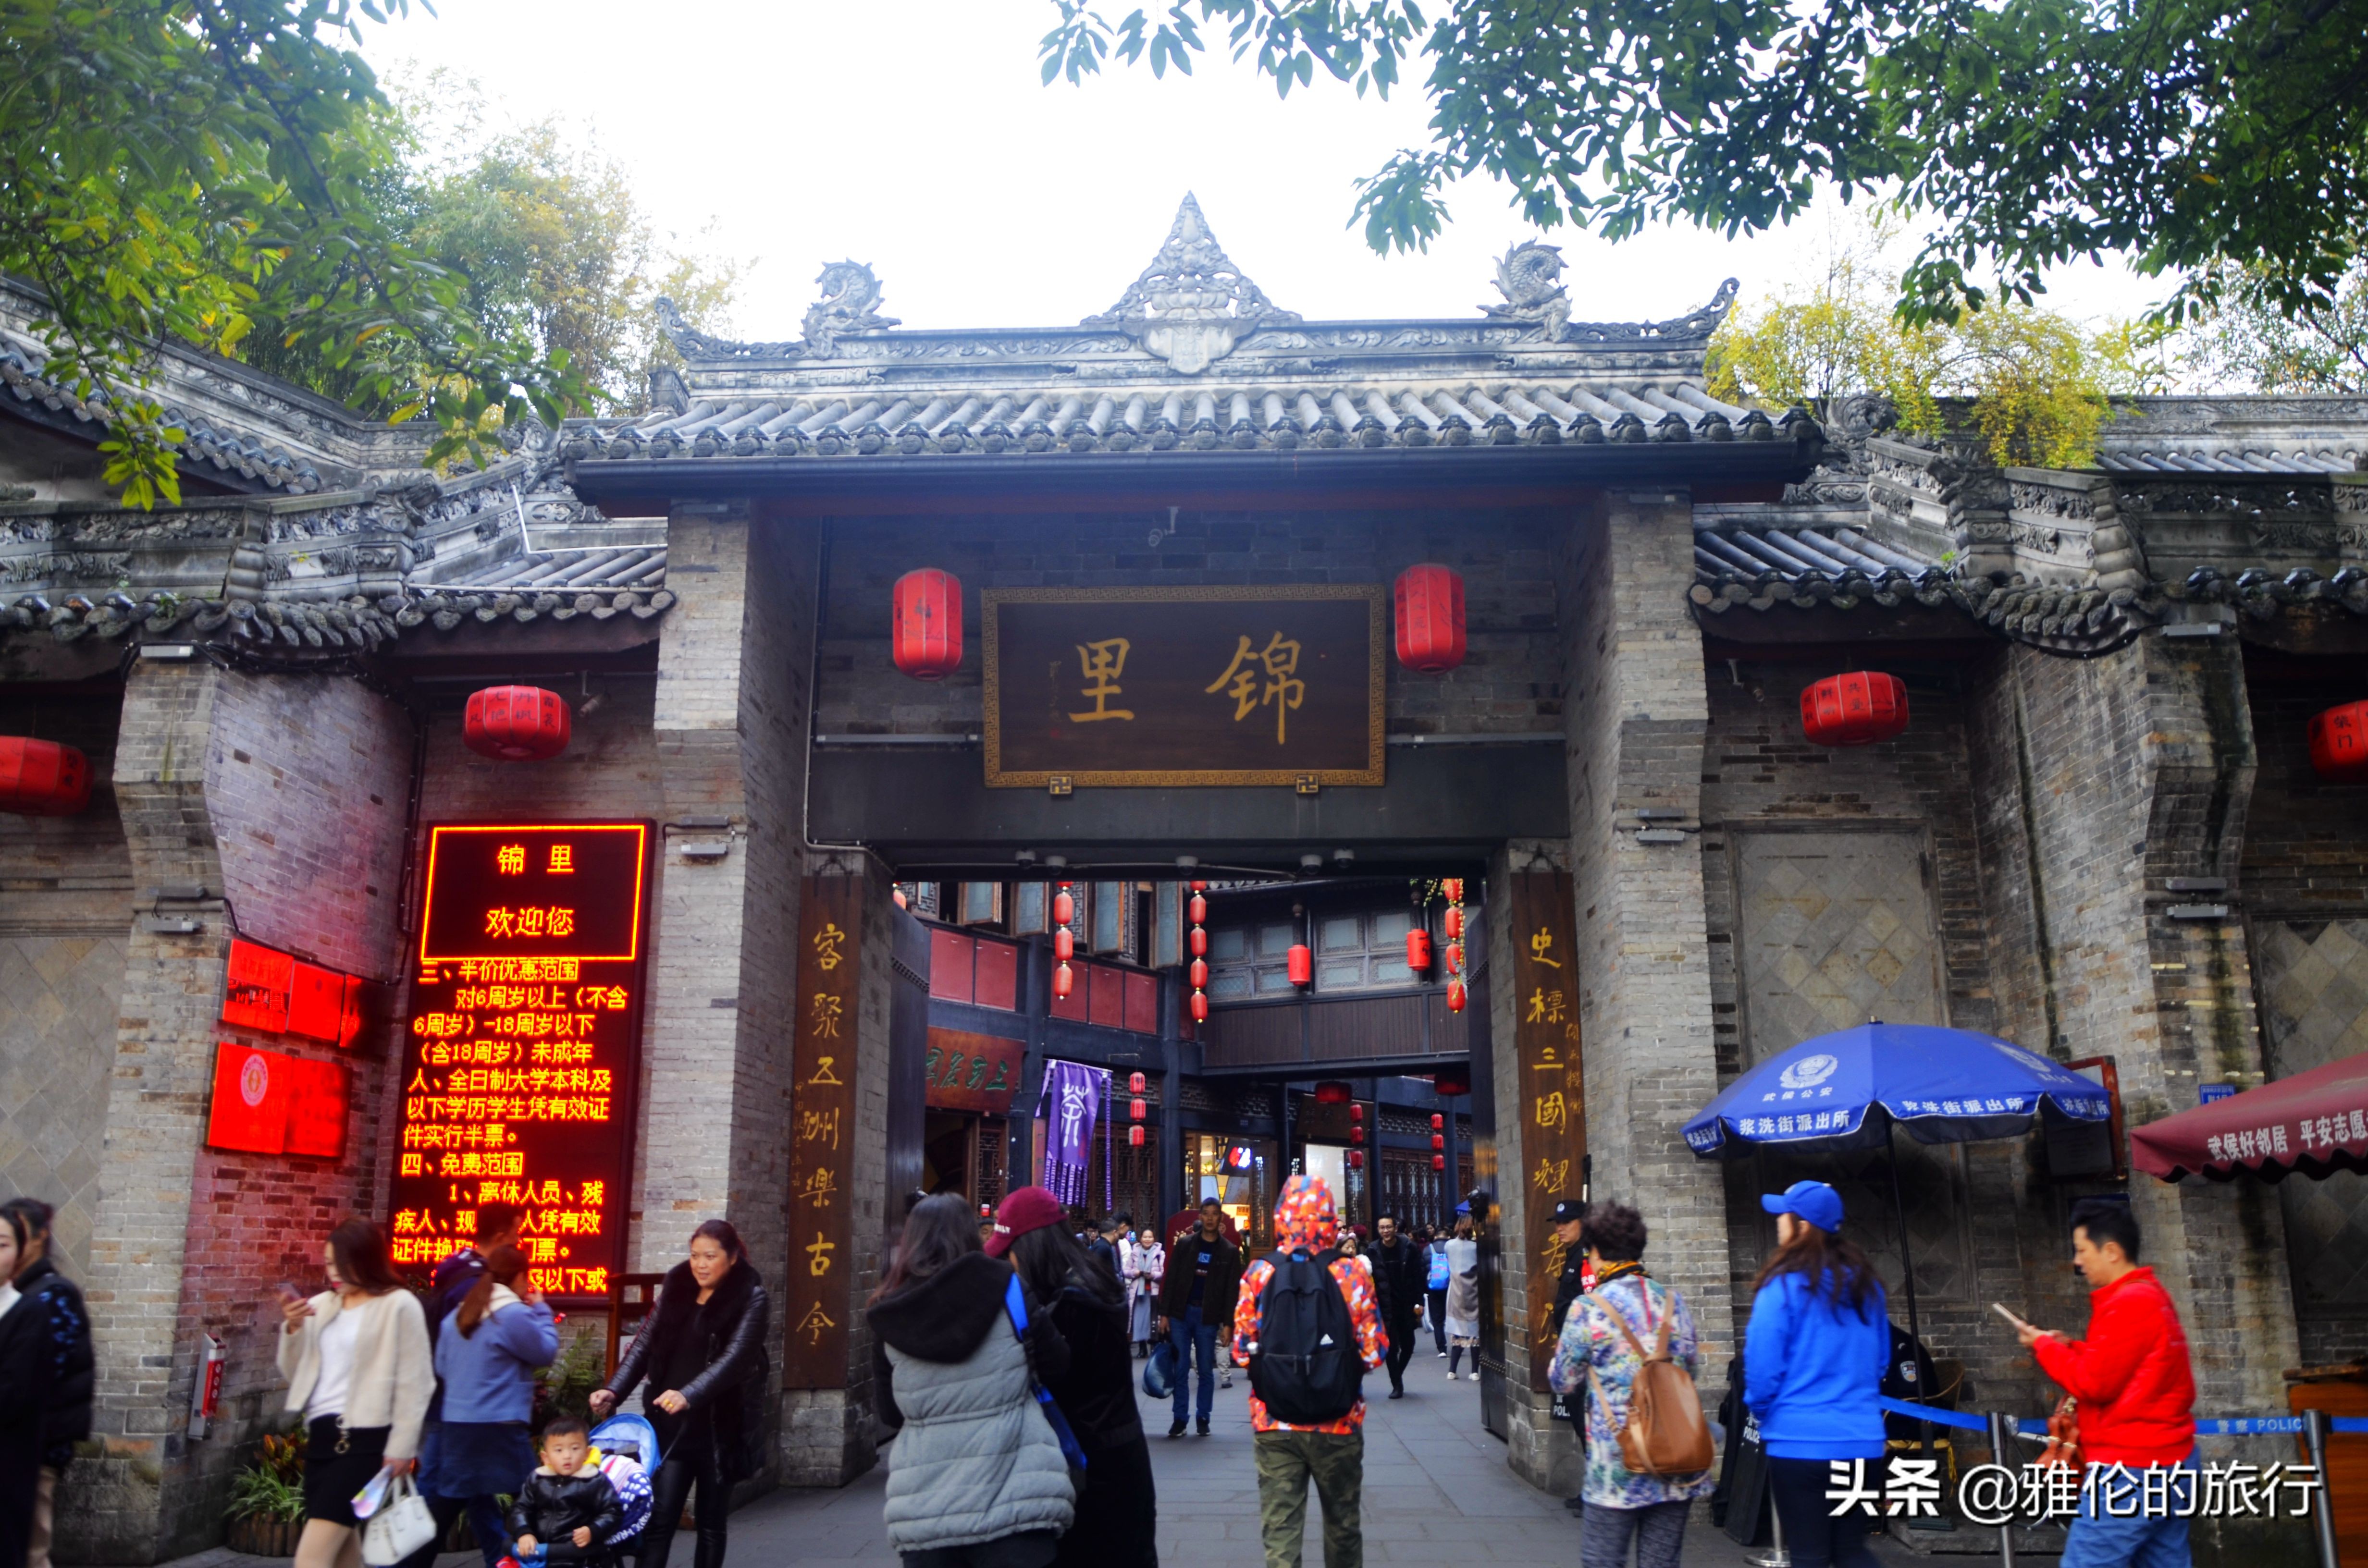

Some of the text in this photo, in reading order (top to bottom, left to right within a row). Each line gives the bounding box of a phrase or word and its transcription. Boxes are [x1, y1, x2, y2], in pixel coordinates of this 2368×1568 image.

[1068, 630, 1305, 745] 锦里
[485, 906, 574, 938] 欢迎您
[419, 958, 580, 983] 三、半价优惠范围
[407, 1067, 612, 1092] 人、全日制大学本科及
[1762, 1086, 1833, 1102] 武侯公安
[407, 1095, 610, 1120] 以下学历学生凭有效证
[403, 1123, 518, 1148] 件实行半票。
[1739, 1110, 1850, 1136] 浆洗街派出所
[2207, 1108, 2368, 1162] 武侯好邻居 平安志愿
[401, 1152, 524, 1176] 四、免费范围
[449, 1180, 604, 1206] 1、离休人员、残
[2257, 1418, 2303, 1431] POLIC
